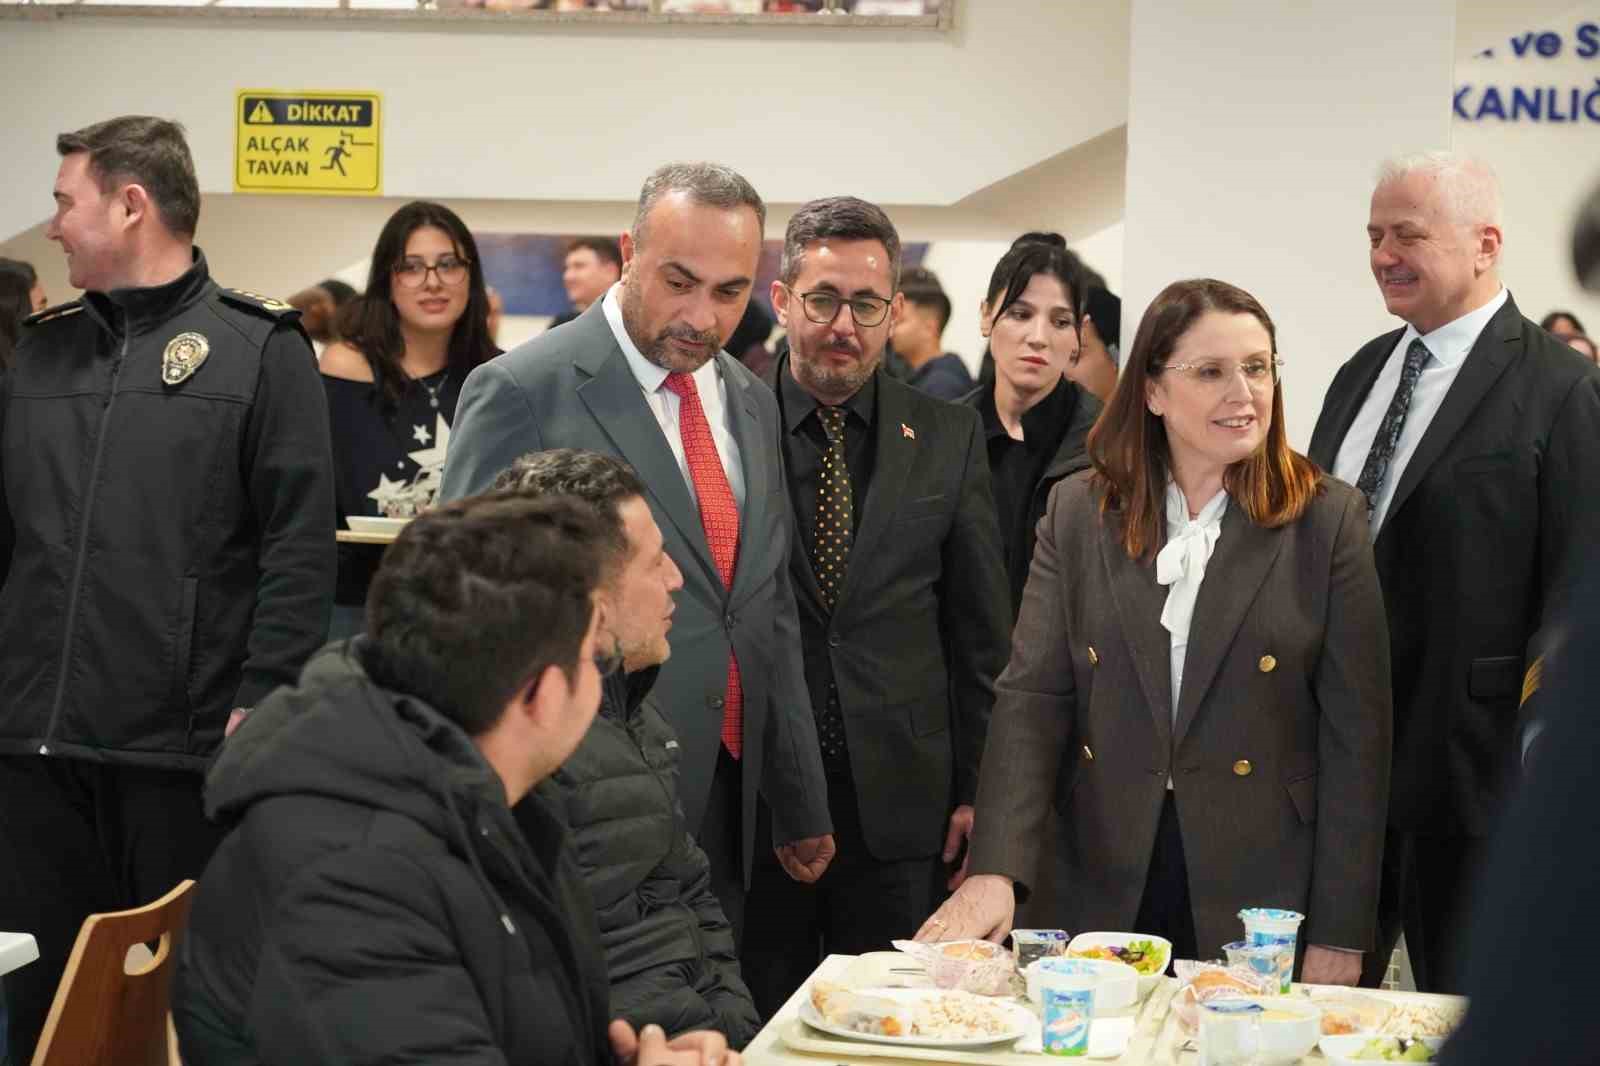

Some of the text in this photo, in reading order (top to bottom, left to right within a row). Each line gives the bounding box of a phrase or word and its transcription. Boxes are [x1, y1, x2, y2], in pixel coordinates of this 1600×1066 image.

[1511, 32, 1562, 58] ve
[287, 102, 361, 122] DİKKAT
[246, 136, 310, 156] ALÇAK
[246, 160, 309, 175] TAVAN
